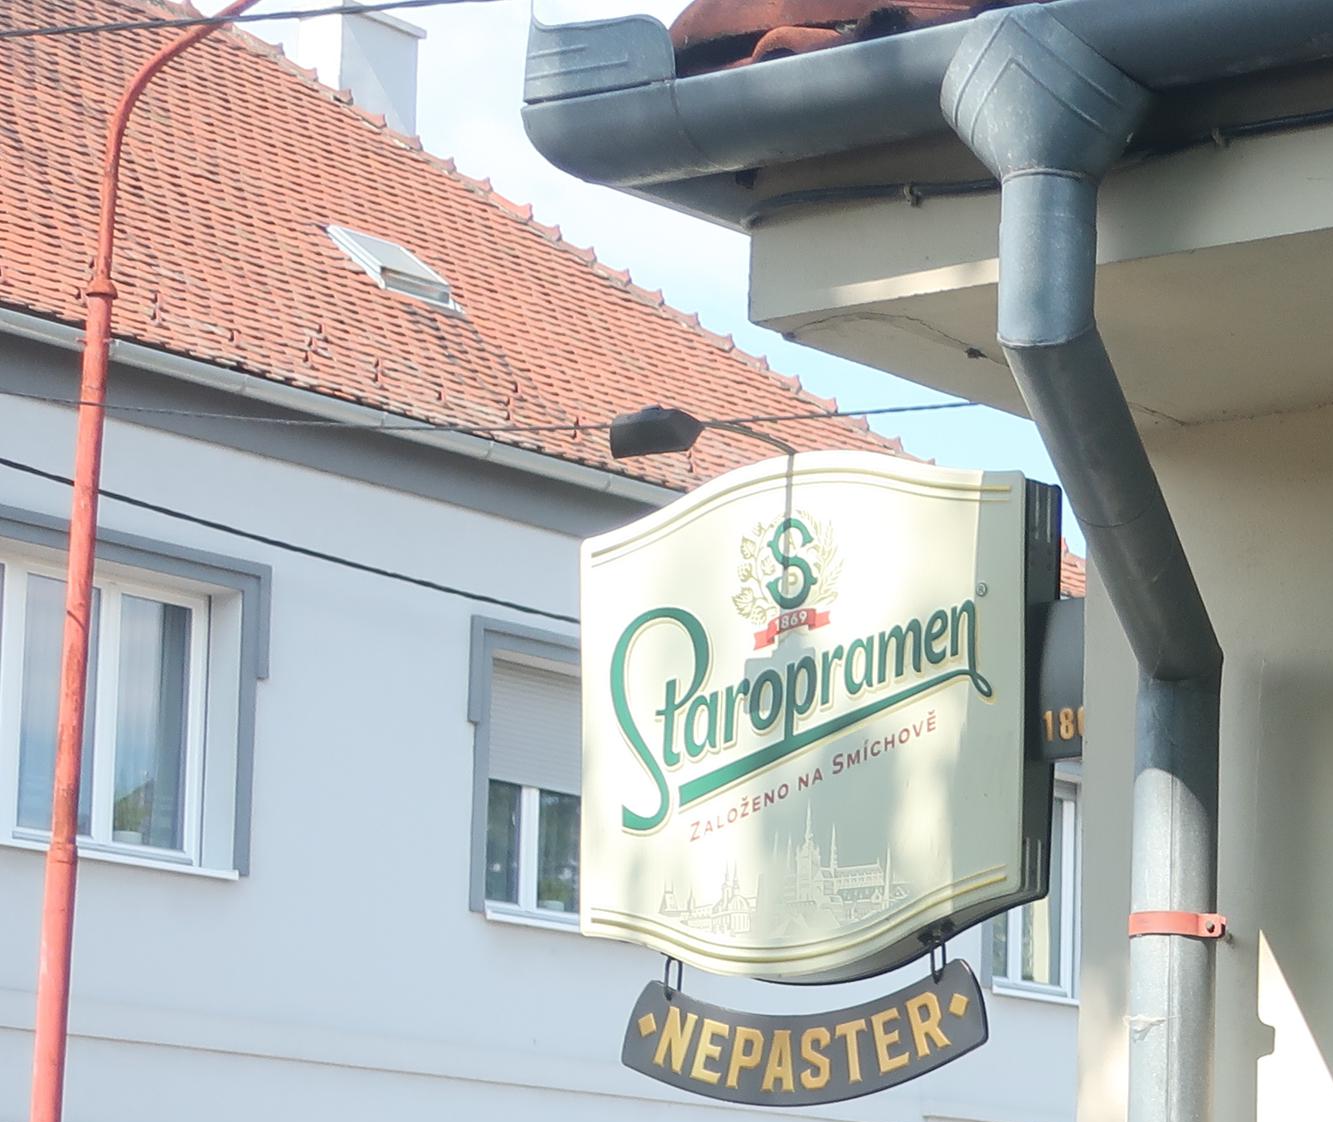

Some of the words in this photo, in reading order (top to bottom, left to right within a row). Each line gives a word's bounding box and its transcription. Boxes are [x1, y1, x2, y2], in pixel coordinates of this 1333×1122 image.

[776, 611, 808, 633] 1869
[610, 598, 993, 833] Staropramen
[798, 768, 824, 791] NA
[651, 990, 952, 1093] NEPASTER
